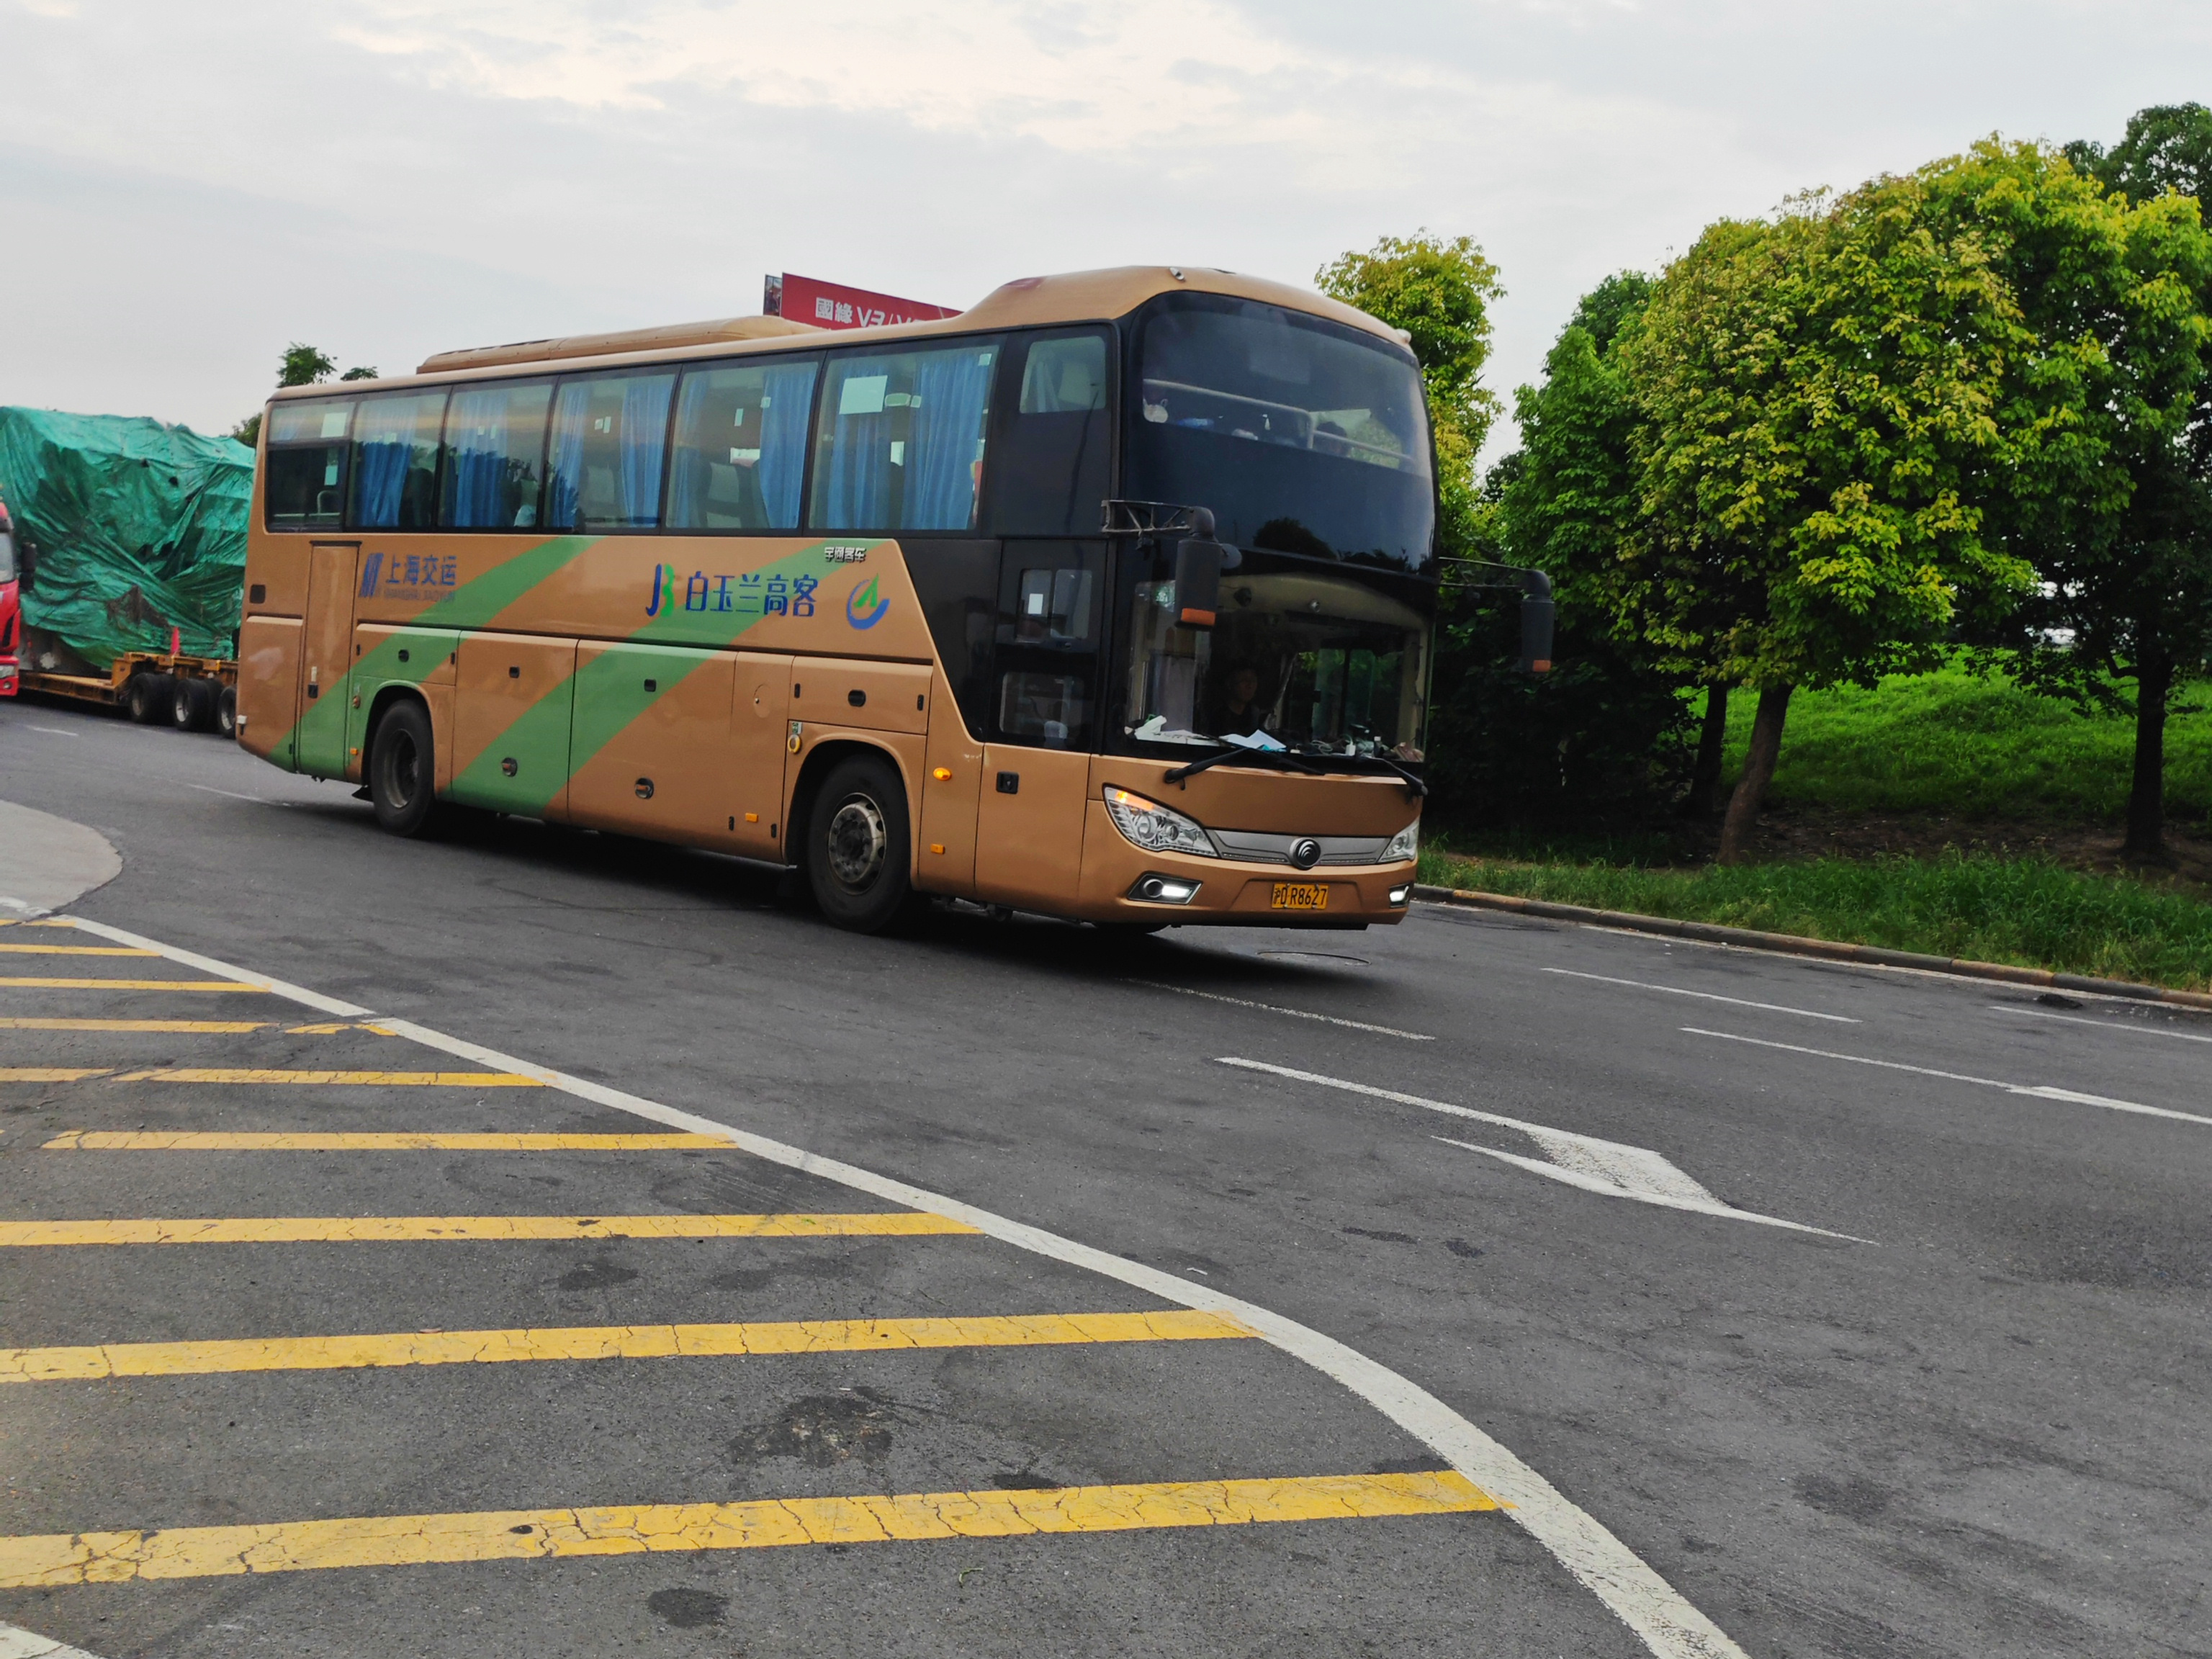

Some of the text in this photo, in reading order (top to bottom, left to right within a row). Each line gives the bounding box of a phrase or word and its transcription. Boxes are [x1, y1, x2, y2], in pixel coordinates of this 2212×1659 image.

[385, 554, 457, 586] 上海交运
[824, 547, 866, 562] 宇通客车
[685, 570, 819, 617] 白玉兰高客
